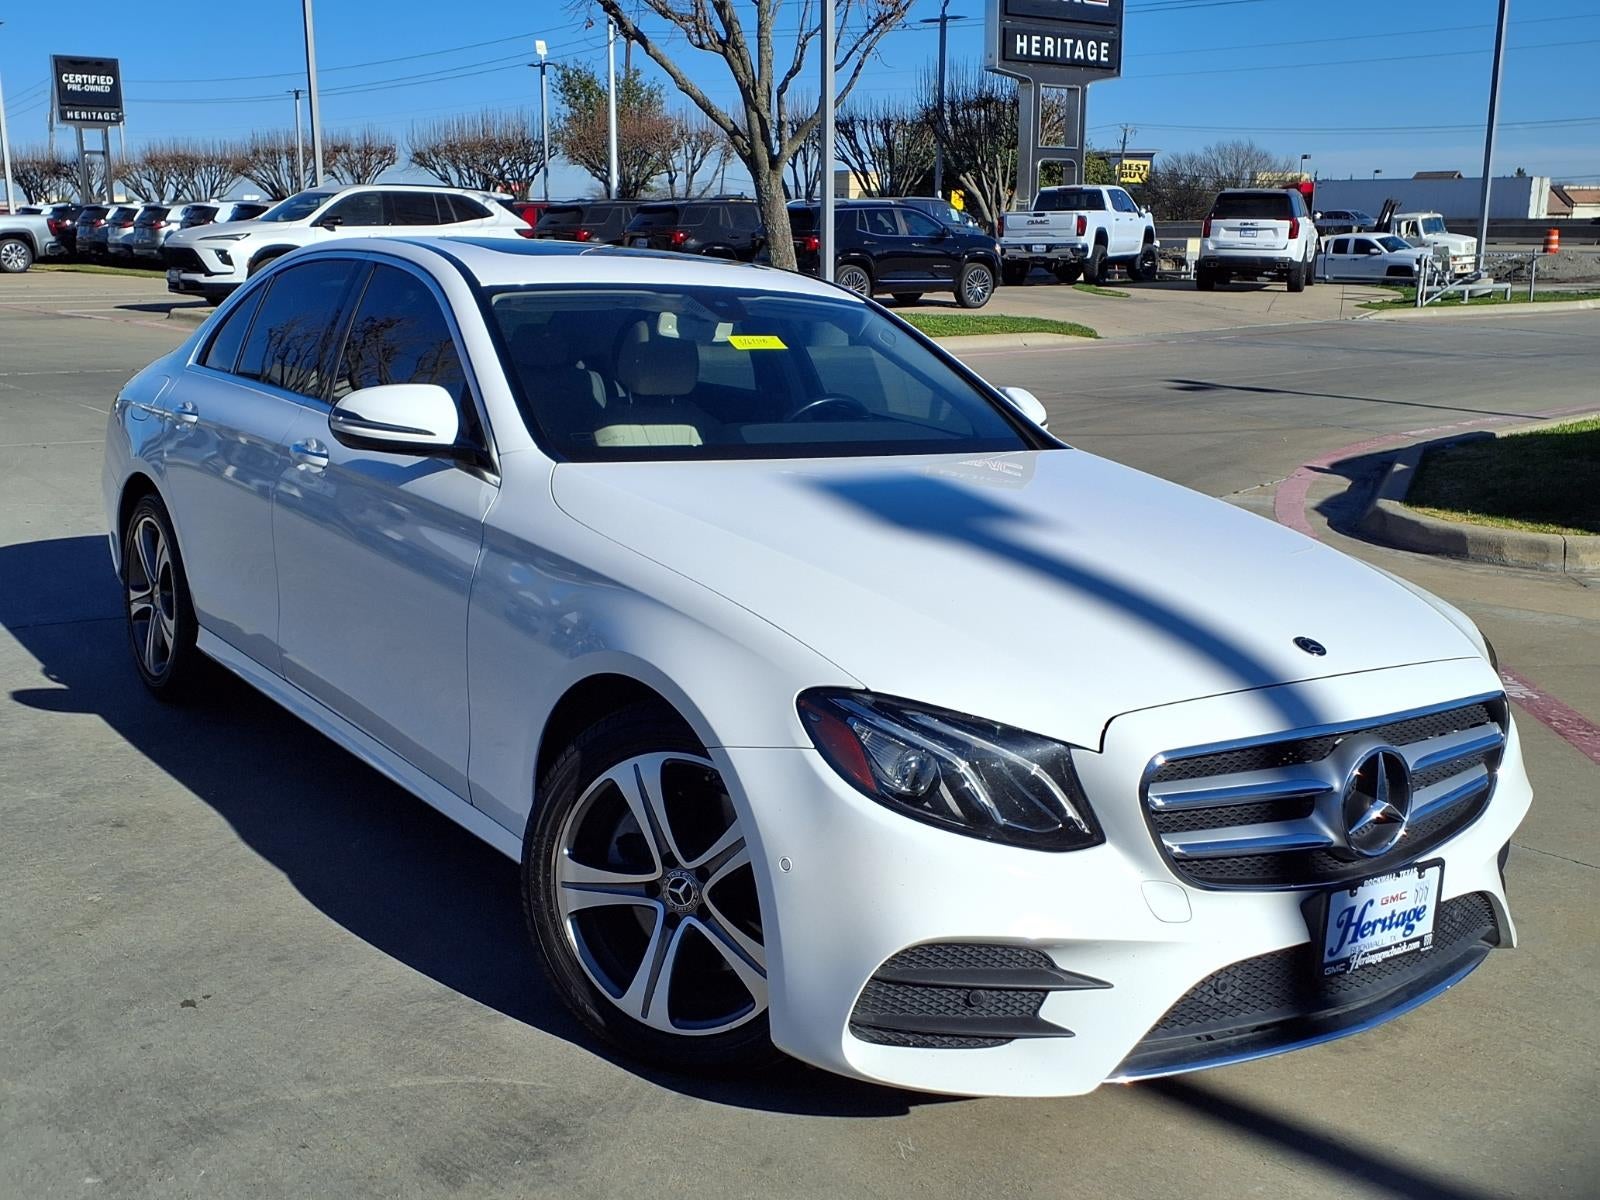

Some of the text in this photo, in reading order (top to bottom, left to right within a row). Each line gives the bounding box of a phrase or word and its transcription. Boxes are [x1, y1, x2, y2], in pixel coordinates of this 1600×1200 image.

[1016, 34, 1109, 62] HERITAGE
[62, 74, 114, 85] CERTIFIED
[67, 84, 110, 92] PRE-OWNED
[67, 111, 117, 120] HERITAGE
[1120, 163, 1148, 171] BEST
[1121, 171, 1145, 179] BUY
[1381, 891, 1408, 906] GMC
[1327, 899, 1427, 957] Heritage
[1324, 963, 1346, 976] GMC
